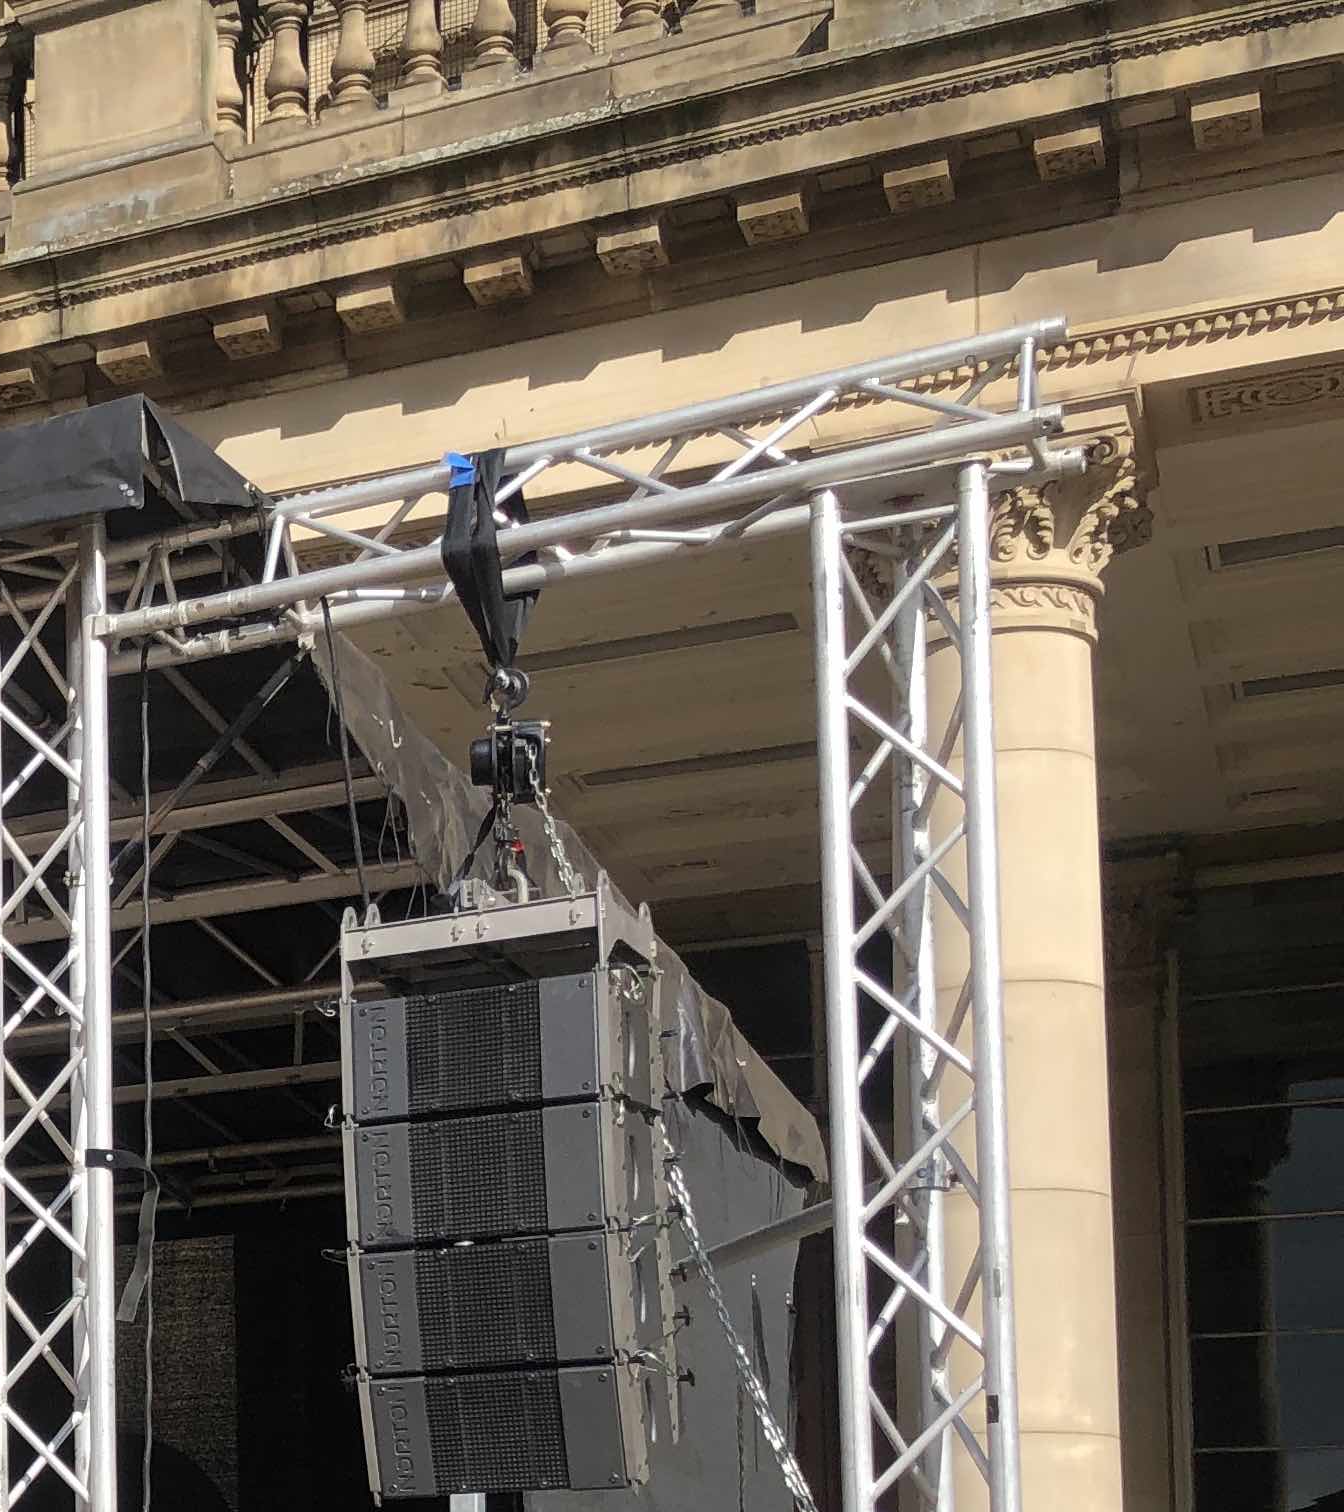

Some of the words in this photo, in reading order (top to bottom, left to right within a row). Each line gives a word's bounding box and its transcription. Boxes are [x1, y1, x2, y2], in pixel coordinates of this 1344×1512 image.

[369, 1006, 389, 1112] NORTON
[371, 1131, 394, 1240] NORTON
[378, 1260, 401, 1369] NORTON
[387, 1386, 417, 1493] NORTON
